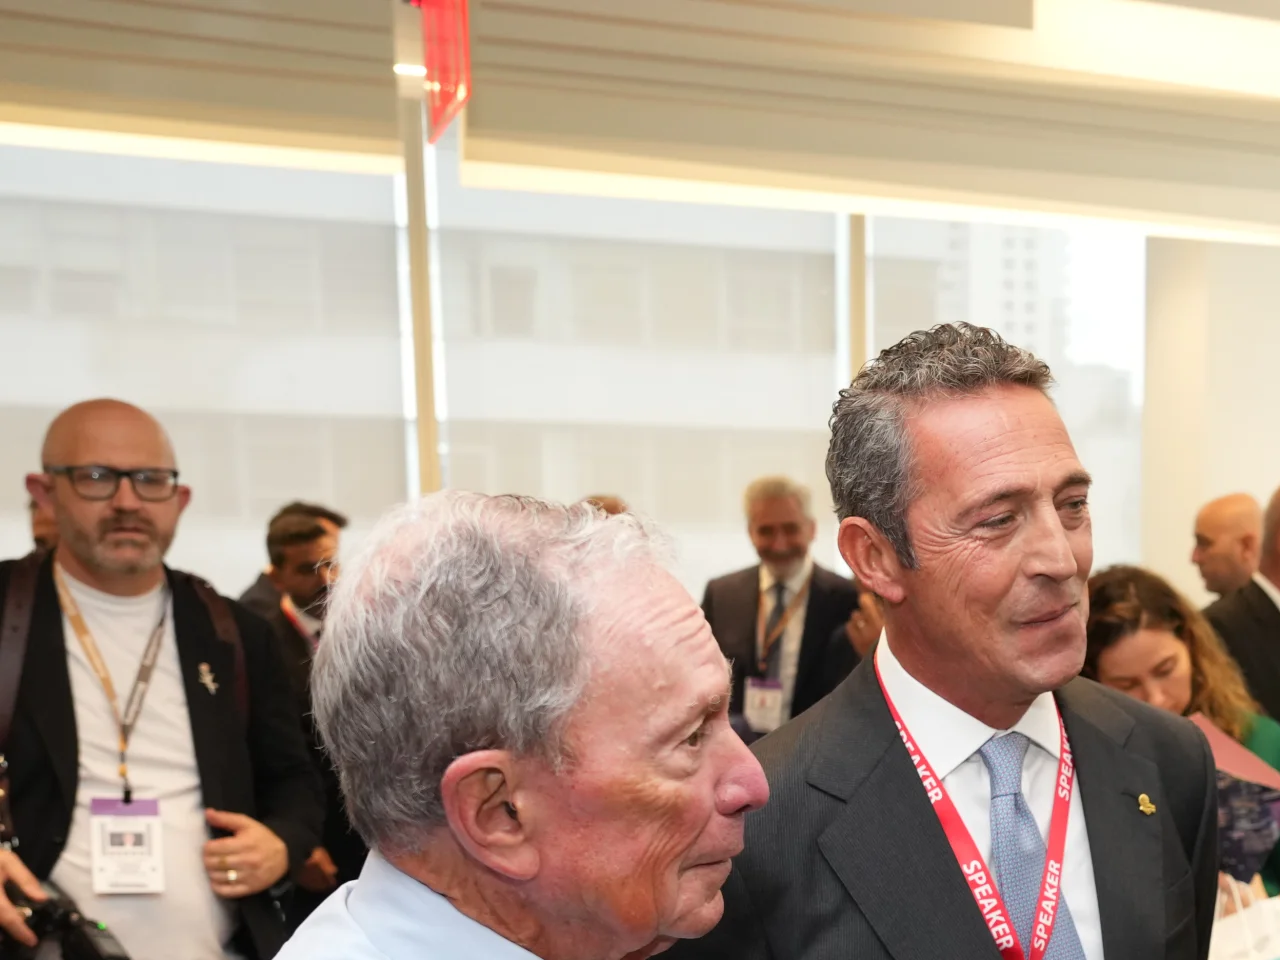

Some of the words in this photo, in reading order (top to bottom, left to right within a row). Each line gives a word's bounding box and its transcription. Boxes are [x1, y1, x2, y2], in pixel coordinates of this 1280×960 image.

[1058, 718, 1073, 802] SPEAK
[963, 859, 1014, 951] SPEAKER
[1034, 859, 1060, 951] SPEAKER
